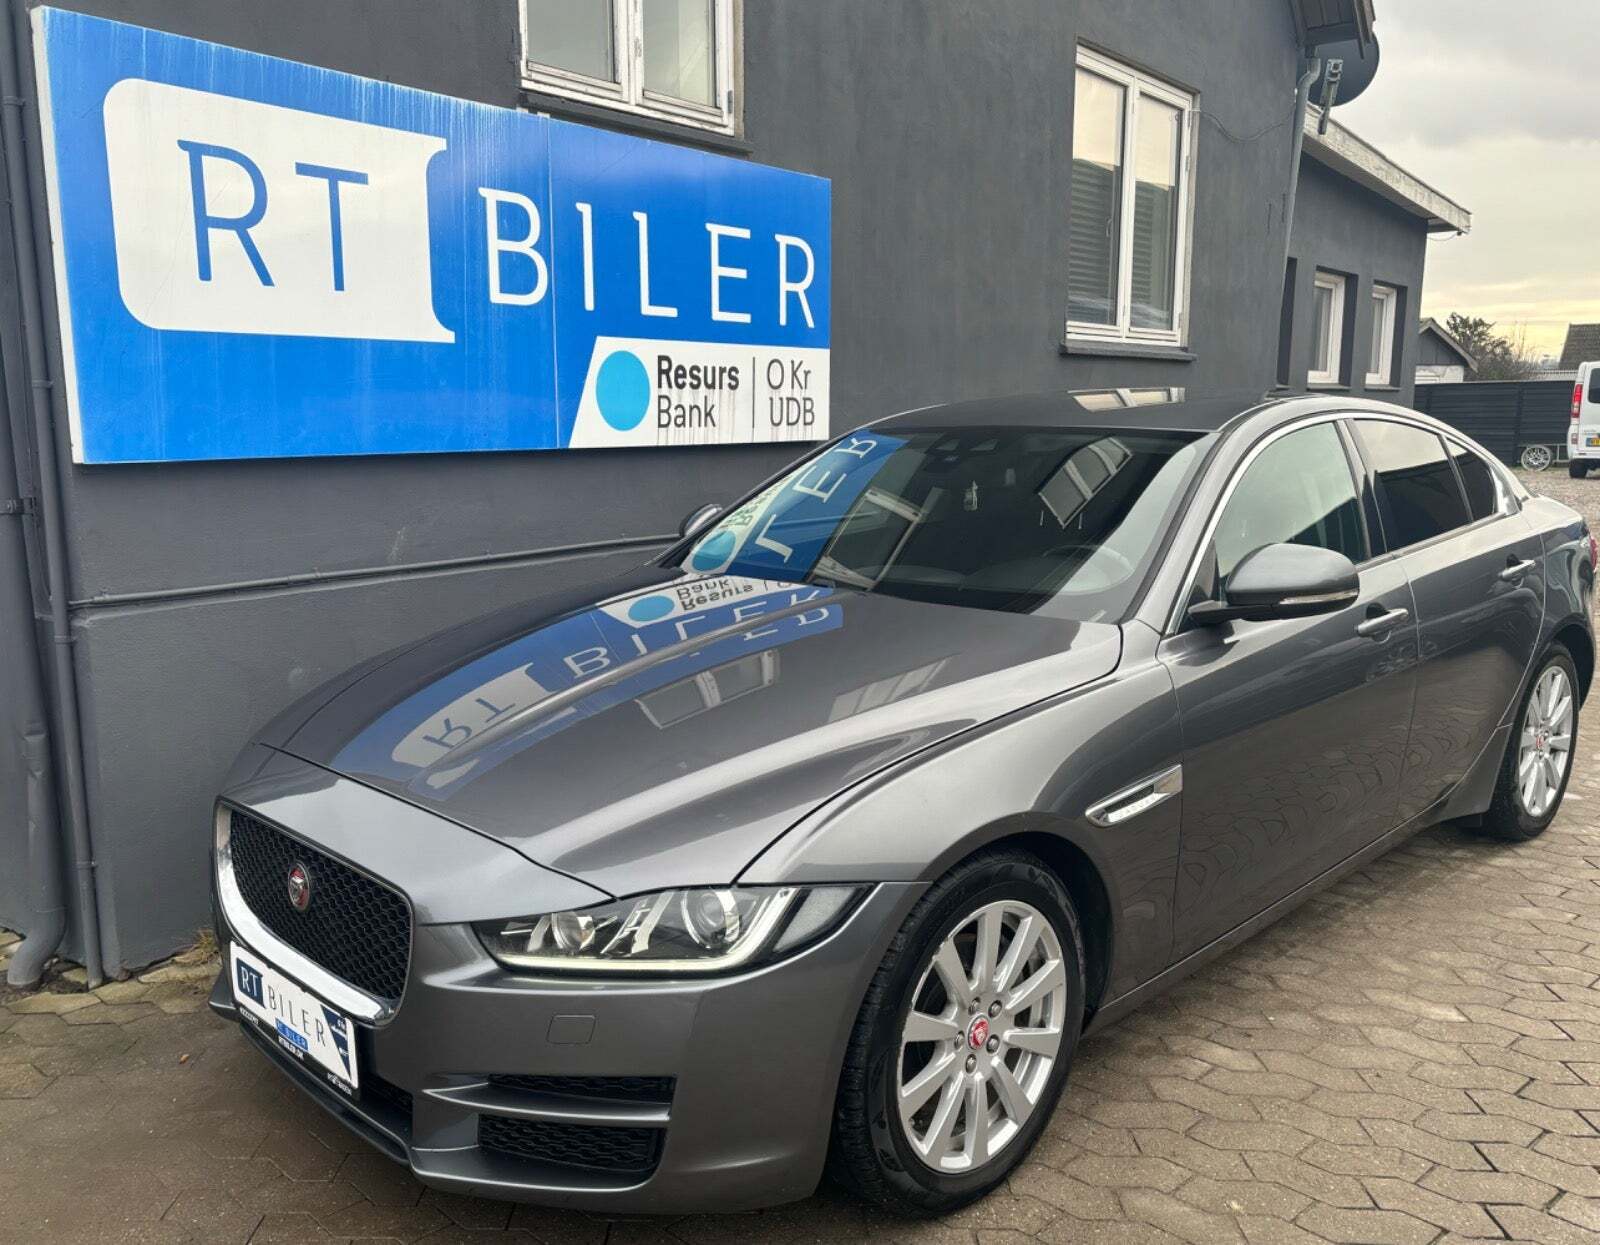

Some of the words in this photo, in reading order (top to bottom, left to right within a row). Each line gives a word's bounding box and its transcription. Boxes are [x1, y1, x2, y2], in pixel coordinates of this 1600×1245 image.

[177, 139, 369, 292] RT
[478, 187, 815, 328] BILER
[657, 354, 740, 391] Resurs
[791, 359, 812, 390] Kr
[657, 394, 717, 428] Bank
[769, 397, 816, 427] UDB
[240, 966, 259, 997] RT
[268, 985, 326, 1047] BILER
